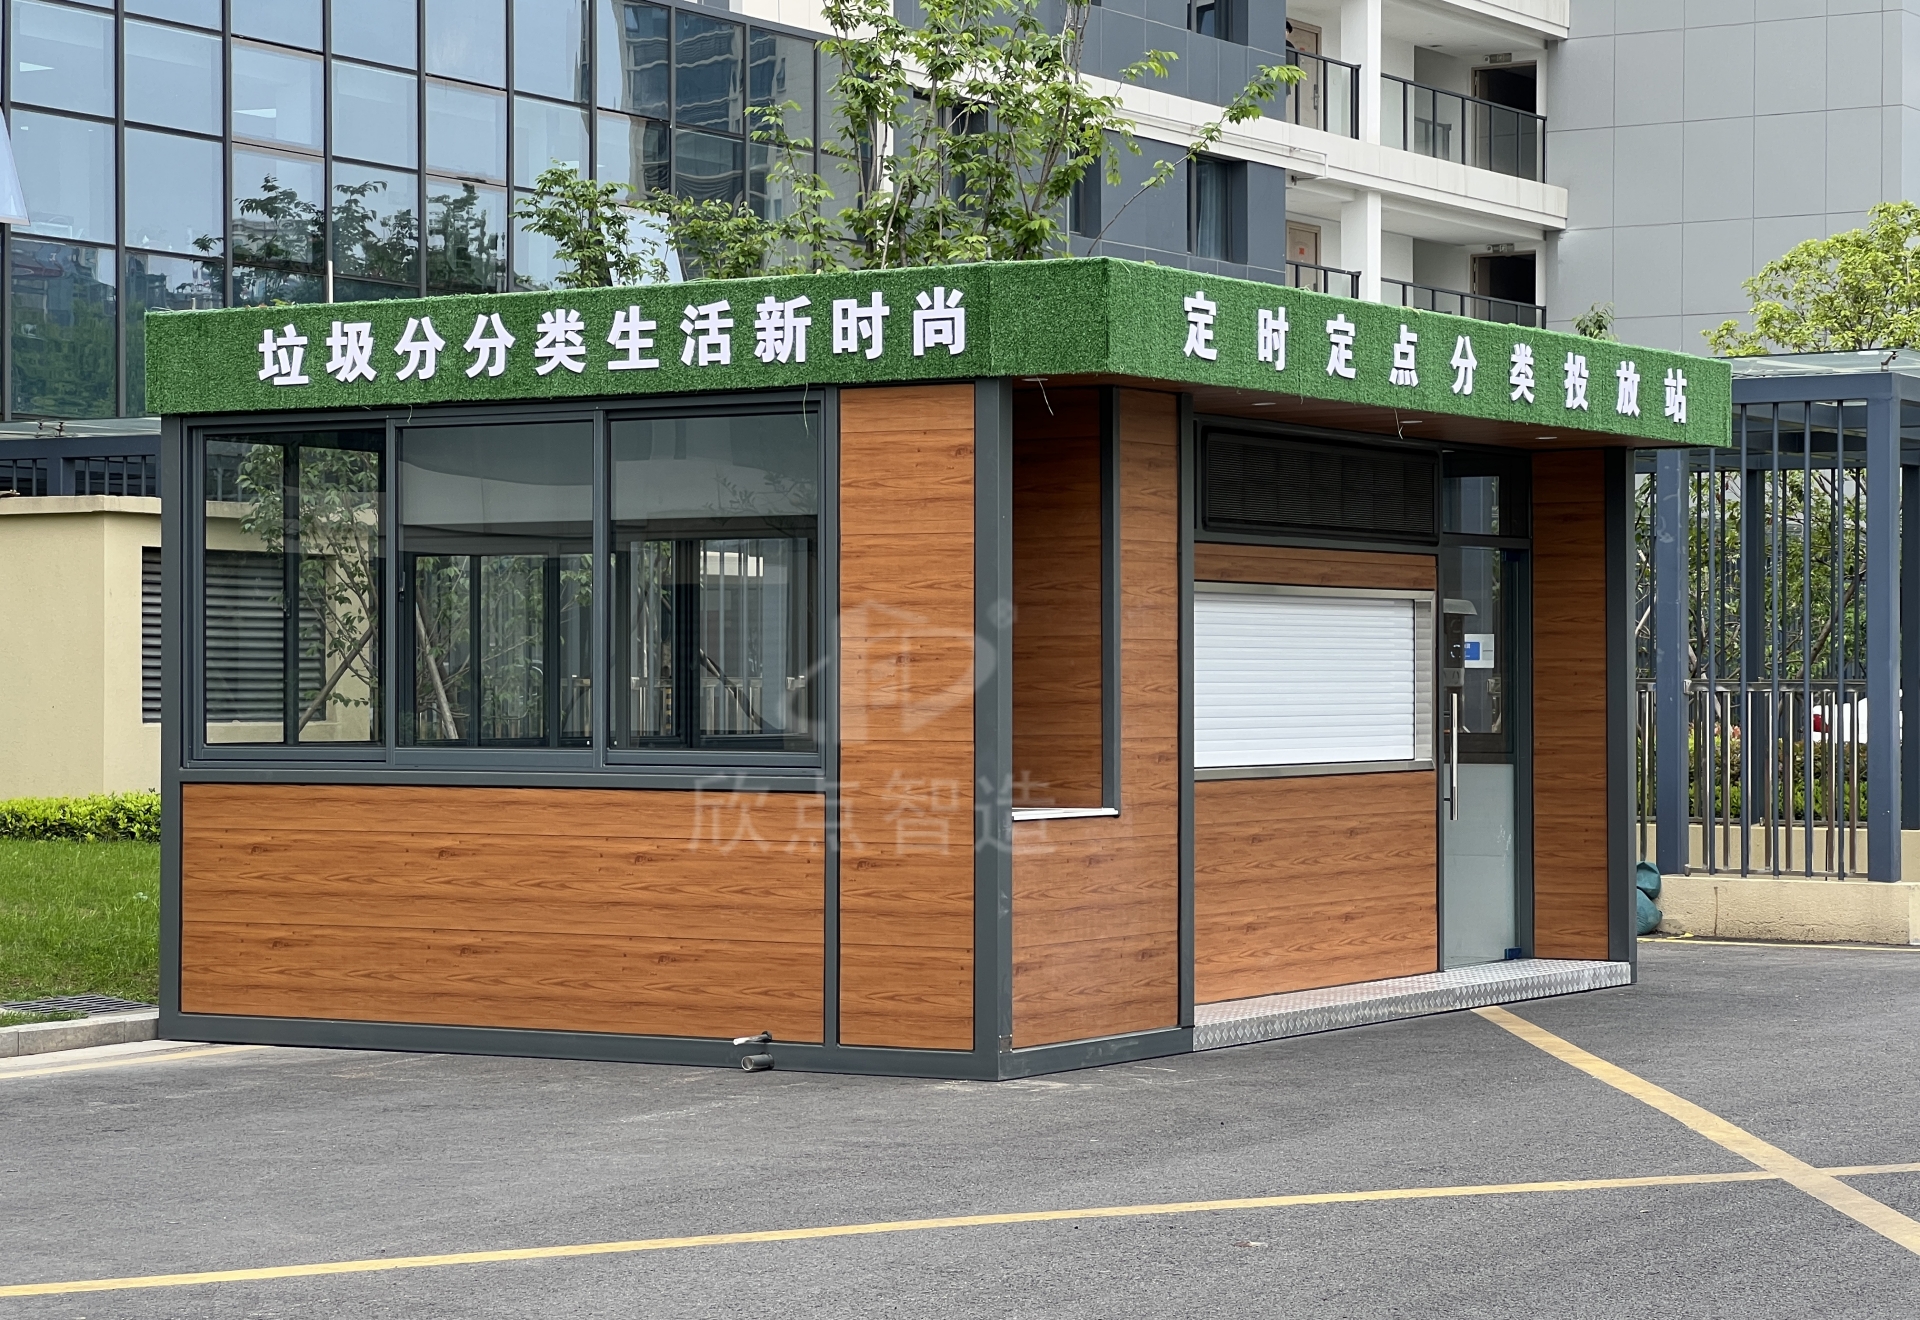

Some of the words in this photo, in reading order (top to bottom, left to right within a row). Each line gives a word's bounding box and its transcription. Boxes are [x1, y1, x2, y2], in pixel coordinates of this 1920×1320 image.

[257, 288, 966, 386] 垃圾分分类生活新时尚
[1182, 290, 1689, 424] 定时定点分类投放站
